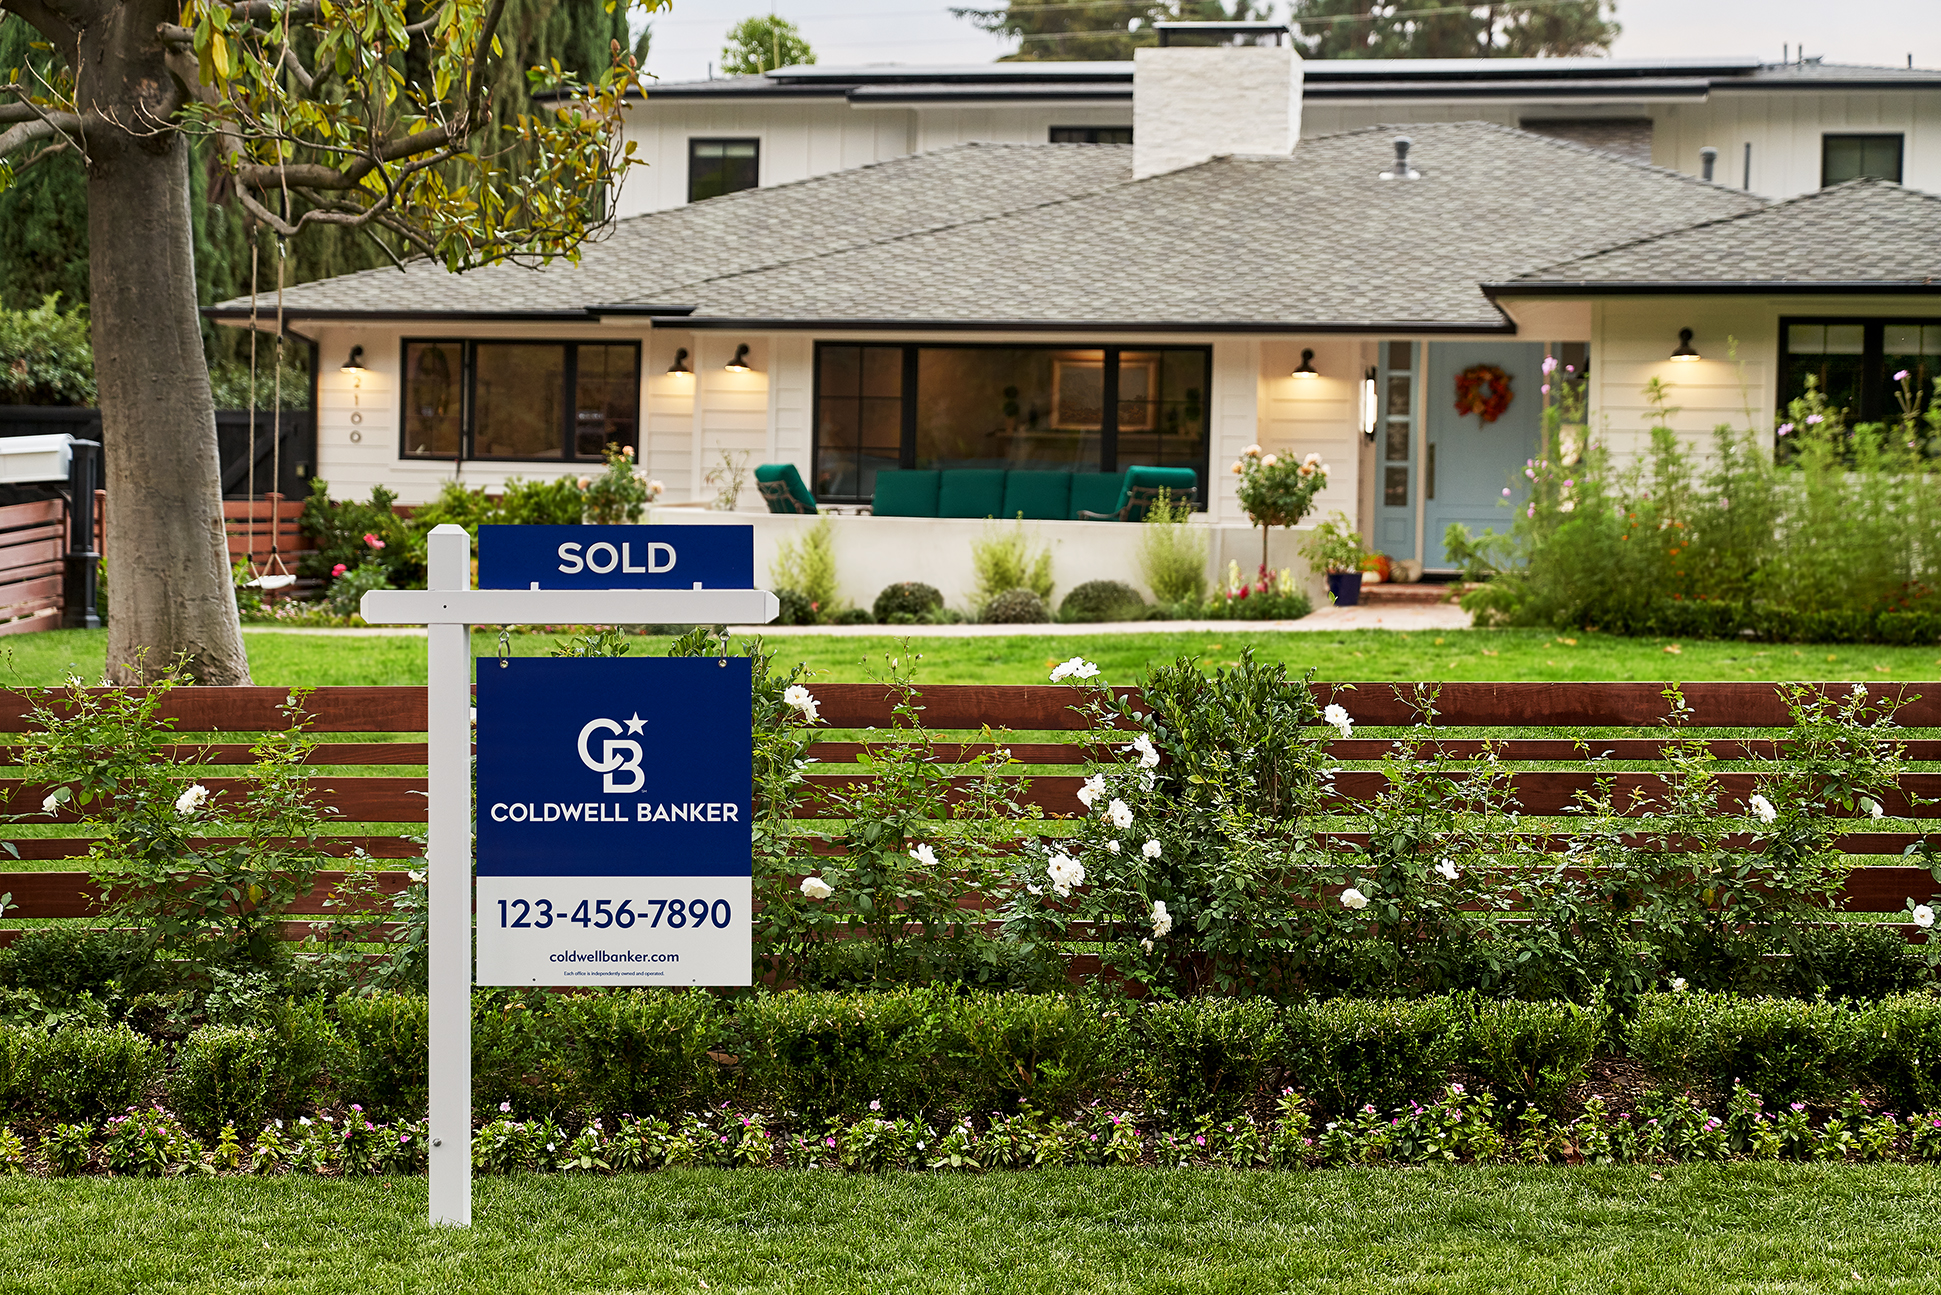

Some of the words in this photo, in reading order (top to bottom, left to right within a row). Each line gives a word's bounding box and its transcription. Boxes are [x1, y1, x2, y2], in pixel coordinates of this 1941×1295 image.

[350, 376, 362, 443] 2100
[557, 541, 677, 574] SOLD
[577, 717, 645, 794] CB
[490, 802, 629, 823] COLDWELL
[637, 802, 739, 822] BANKER
[497, 898, 732, 929] 123-456-7890
[549, 949, 680, 963] coldwellbanker.com
